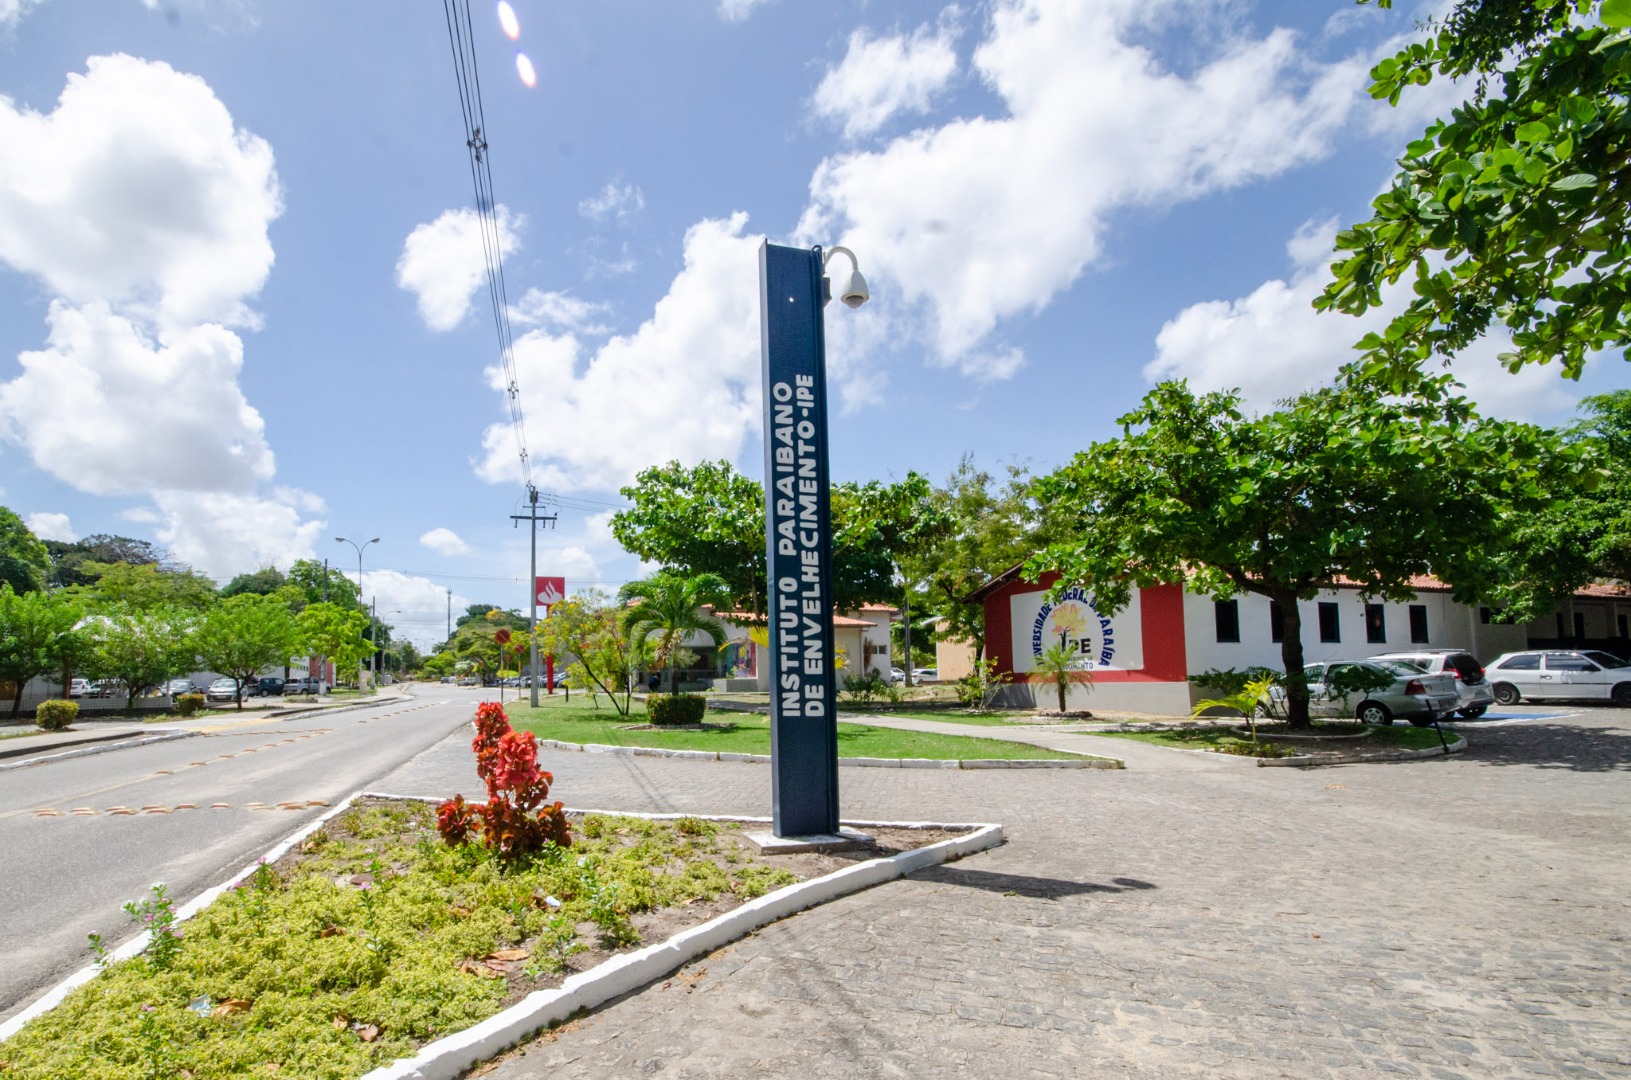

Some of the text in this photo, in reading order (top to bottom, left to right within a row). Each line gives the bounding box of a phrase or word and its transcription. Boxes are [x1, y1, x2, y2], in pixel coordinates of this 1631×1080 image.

[773, 381, 801, 717] INSTITUTO PARAIBANO
[805, 683, 825, 717] DE
